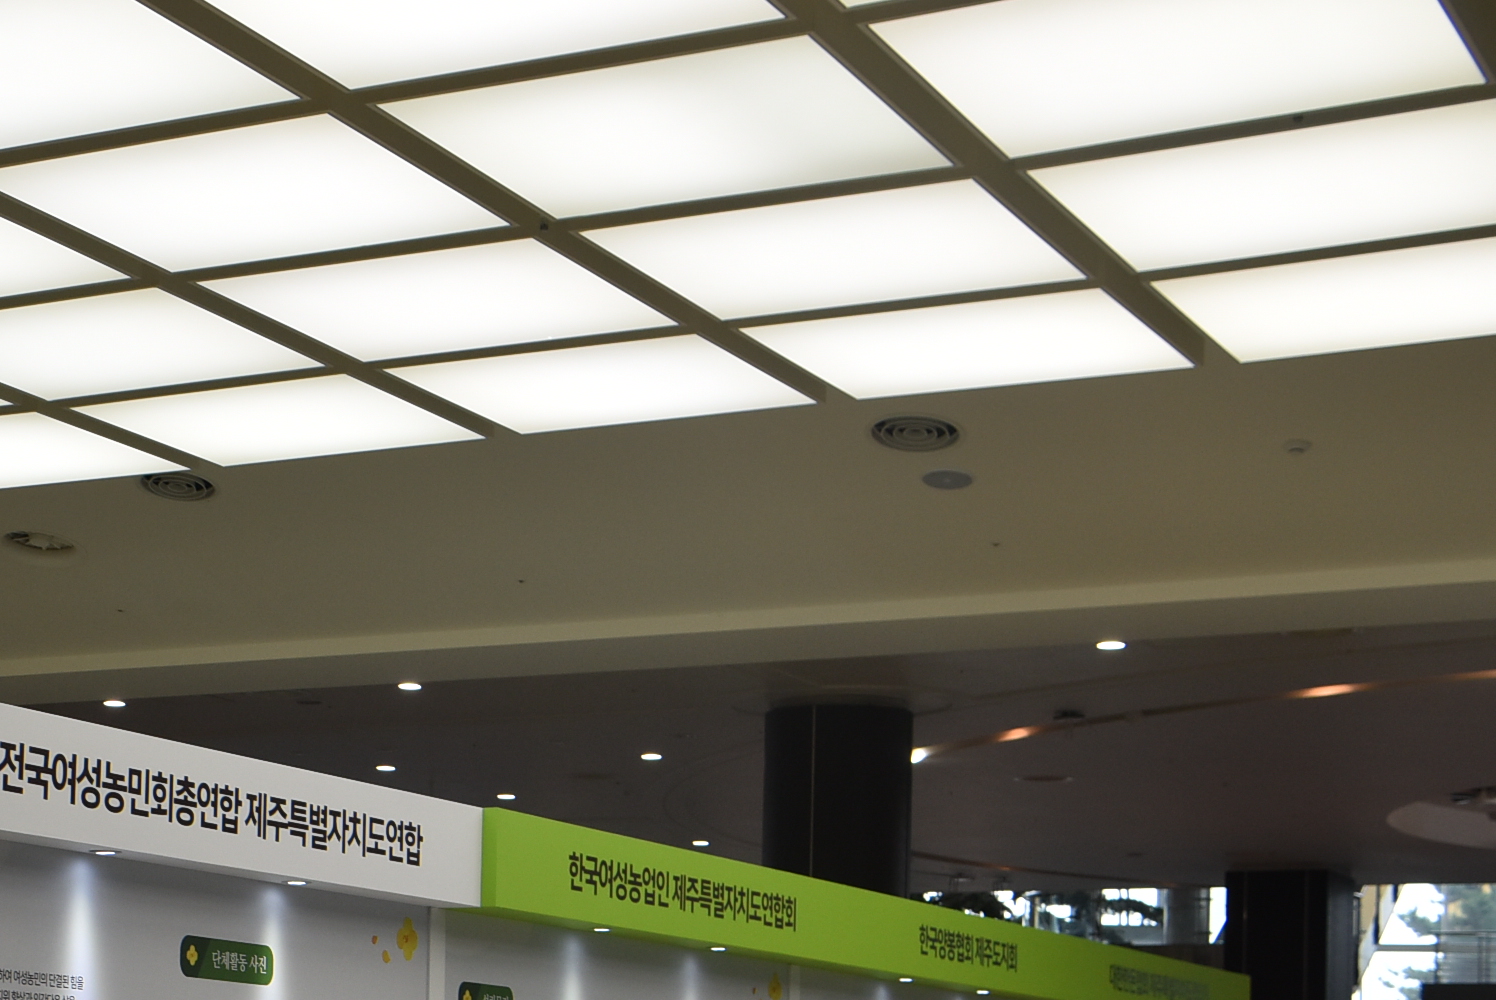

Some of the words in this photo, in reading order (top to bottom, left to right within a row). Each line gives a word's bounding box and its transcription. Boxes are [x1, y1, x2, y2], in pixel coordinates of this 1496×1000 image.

[244, 793, 424, 866] 제주특별자치도연합
[568, 852, 670, 908] 한국여성농업인
[671, 874, 797, 932] 제주특별자치도연합회
[212, 951, 248, 971] 단체활동
[249, 955, 268, 974] 사진
[918, 925, 974, 964] 한국양봉협회
[974, 937, 1018, 972] 제주도지회
[13, 971, 48, 986] 여성농민의
[48, 974, 70, 988] 단결된
